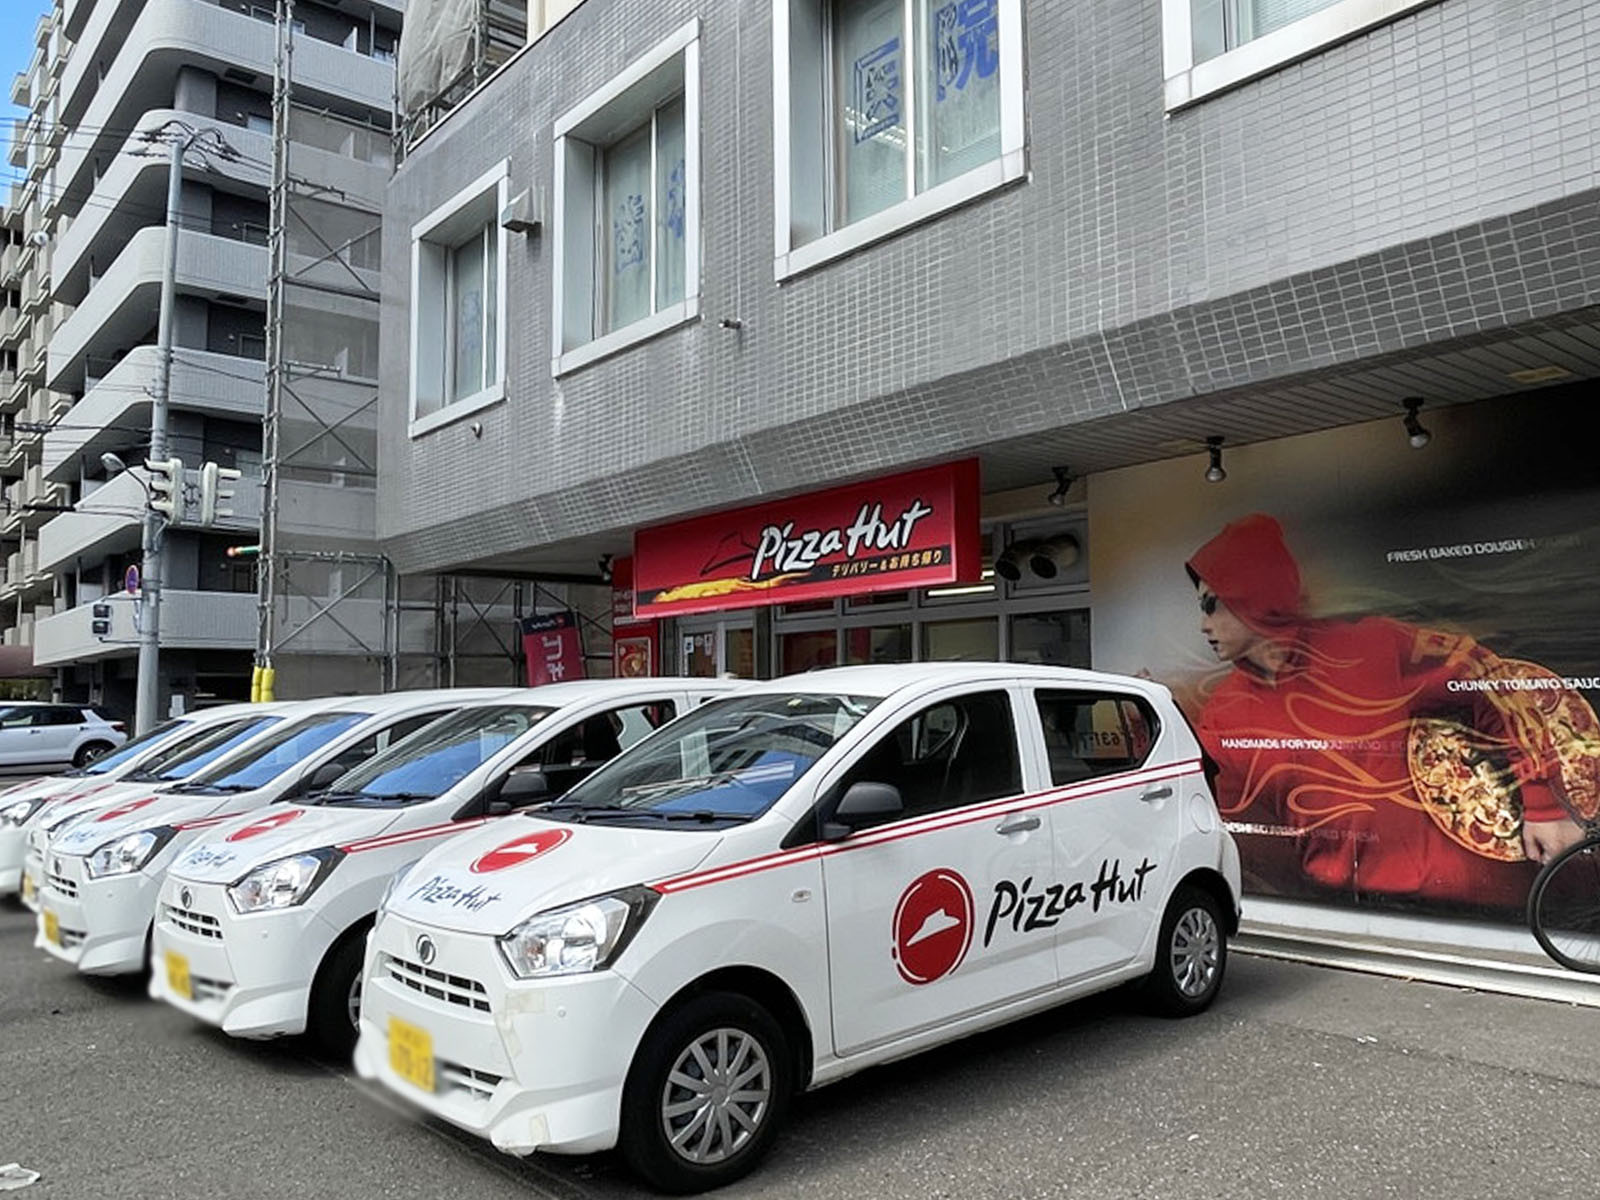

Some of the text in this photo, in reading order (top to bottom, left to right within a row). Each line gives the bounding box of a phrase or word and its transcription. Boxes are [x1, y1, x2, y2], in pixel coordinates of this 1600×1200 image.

[751, 499, 932, 580] Pizza Hut
[1386, 549, 1428, 563] FRESH
[1429, 545, 1473, 559] BAKED
[1474, 539, 1523, 554] DOUGH
[1447, 679, 1500, 692] CHUNKY
[1501, 678, 1561, 690] TOMATO
[1221, 738, 1280, 749] HANDMADE
[1281, 739, 1304, 749] FOR
[1304, 739, 1328, 750] YOU
[408, 875, 503, 912] Pizza Hut
[983, 857, 1158, 948] Pizza Hut
